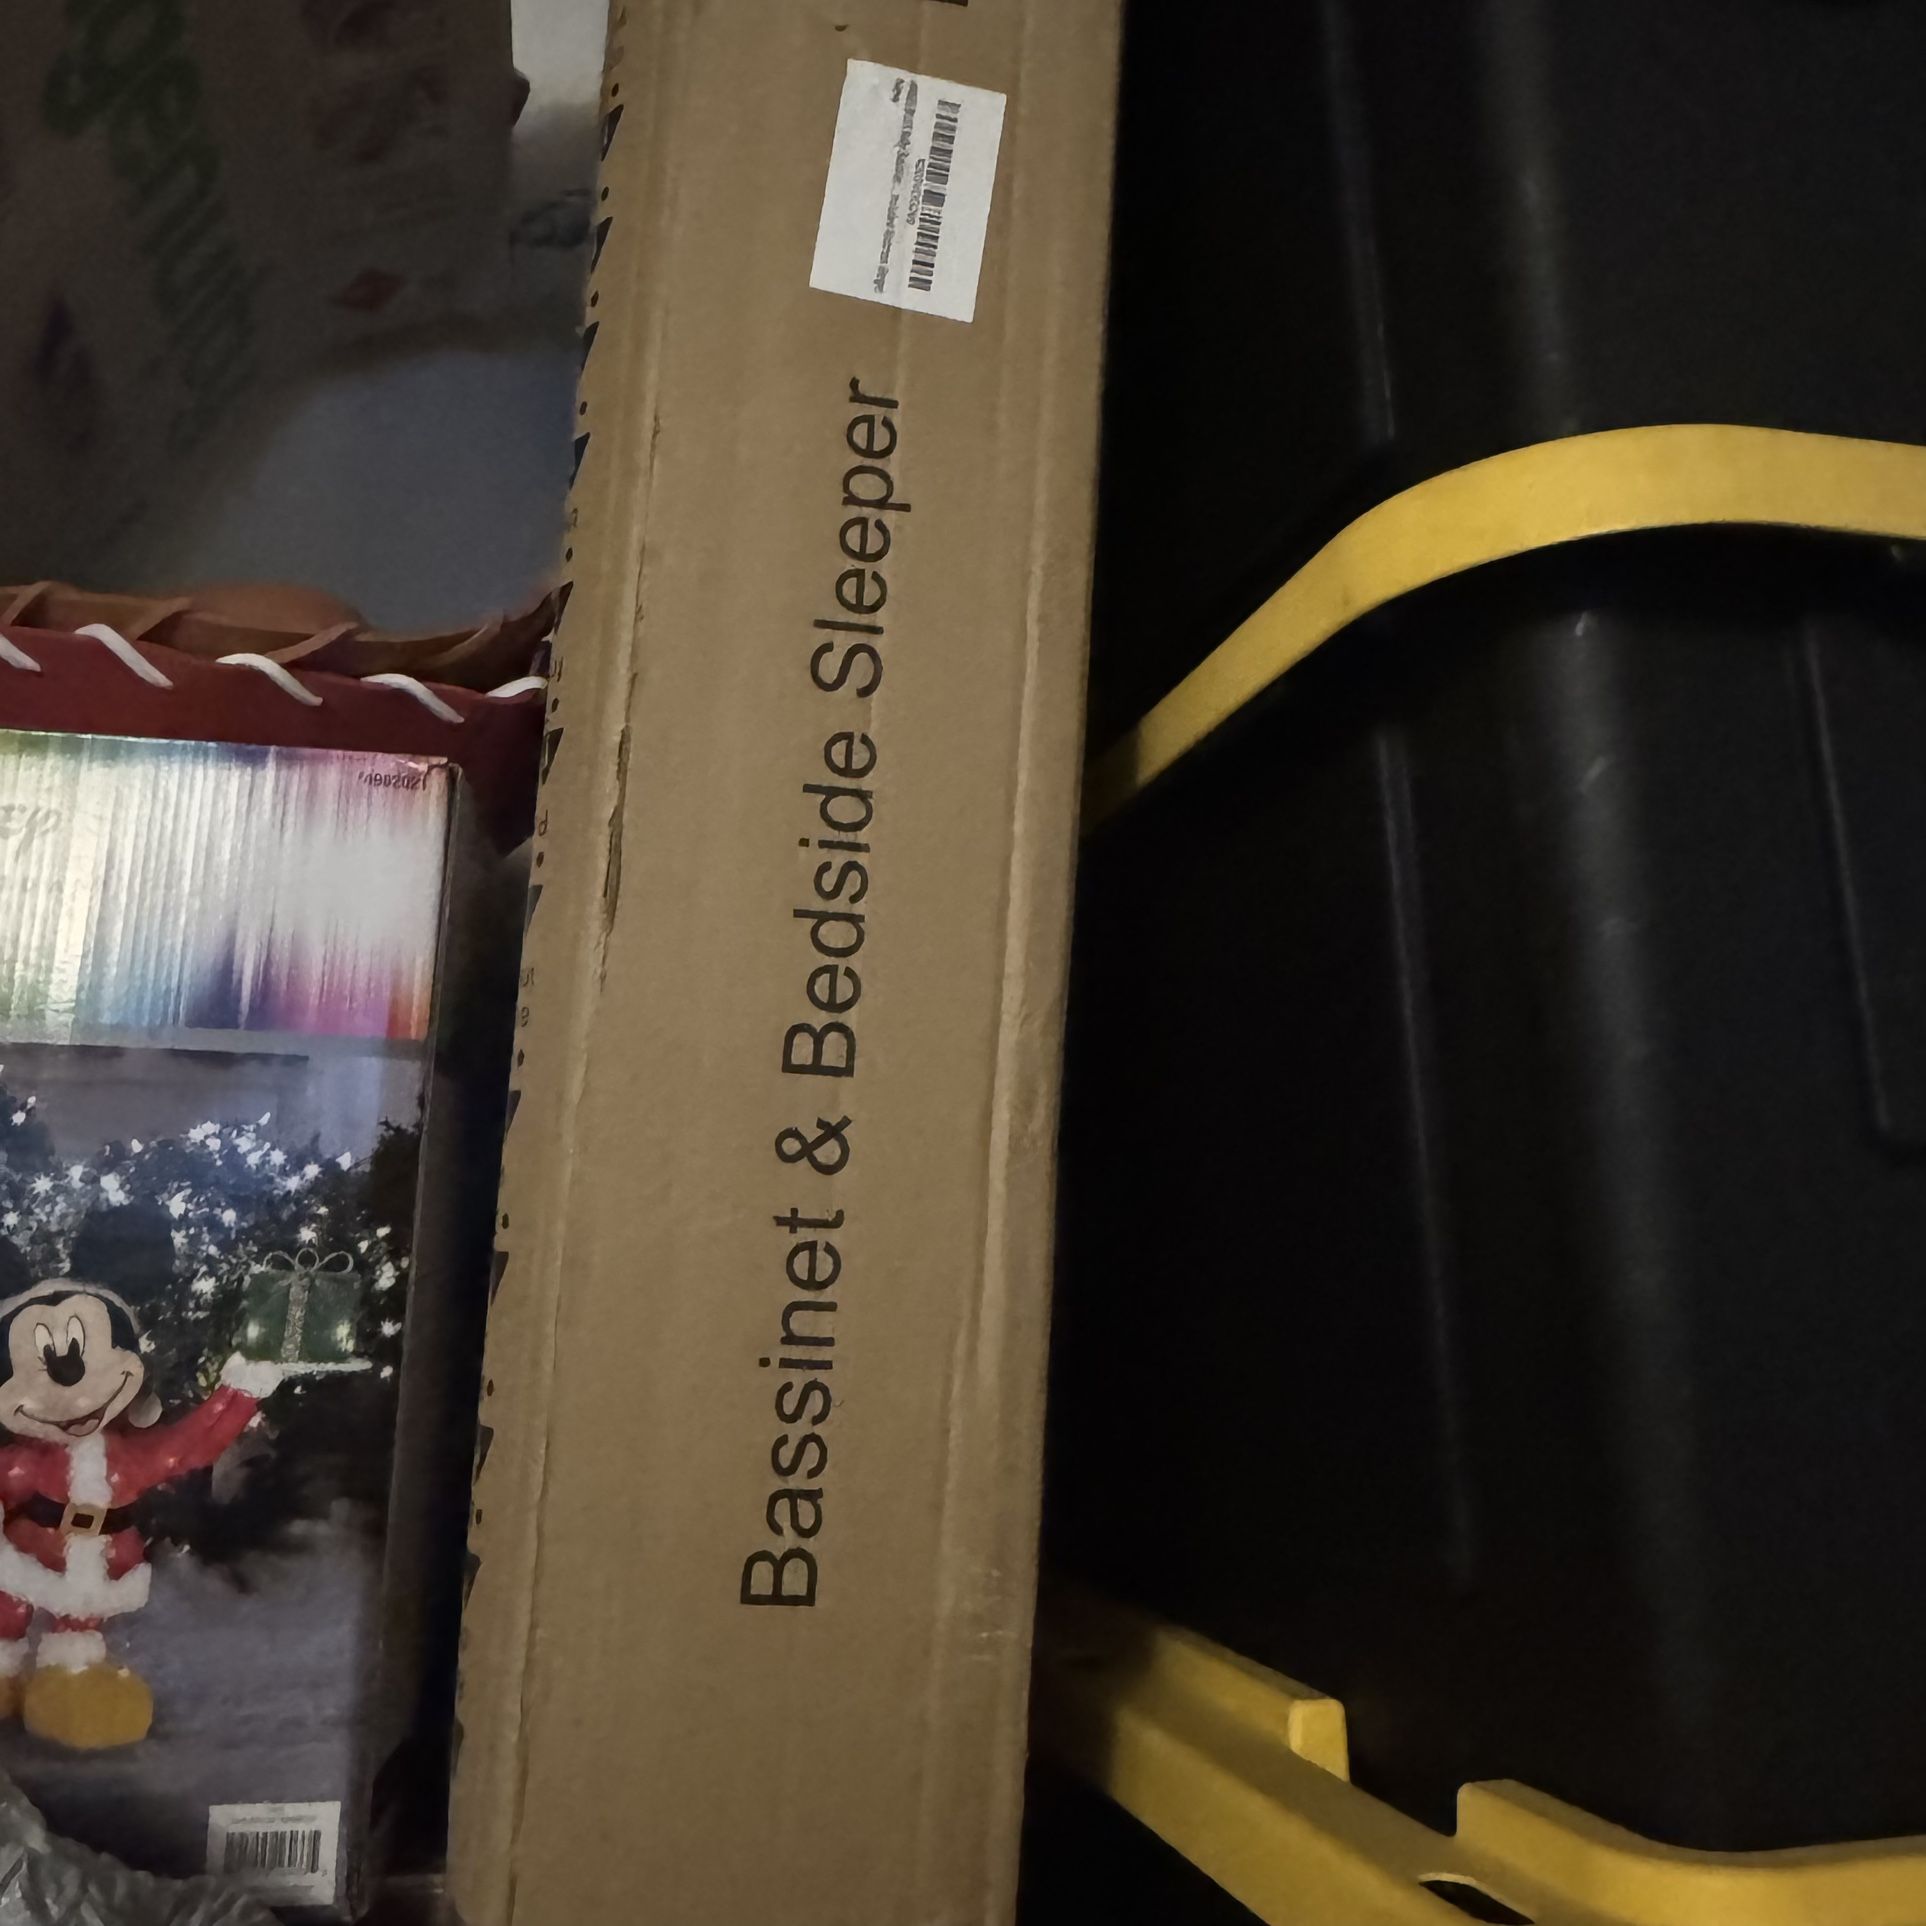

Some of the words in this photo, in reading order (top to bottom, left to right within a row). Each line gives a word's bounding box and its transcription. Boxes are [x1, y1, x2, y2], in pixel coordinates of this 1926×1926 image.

[810, 376, 911, 698] Sleeper
[781, 731, 877, 1078] Bedside
[774, 1116, 852, 1176] &
[740, 1207, 845, 1607] Bassinet
